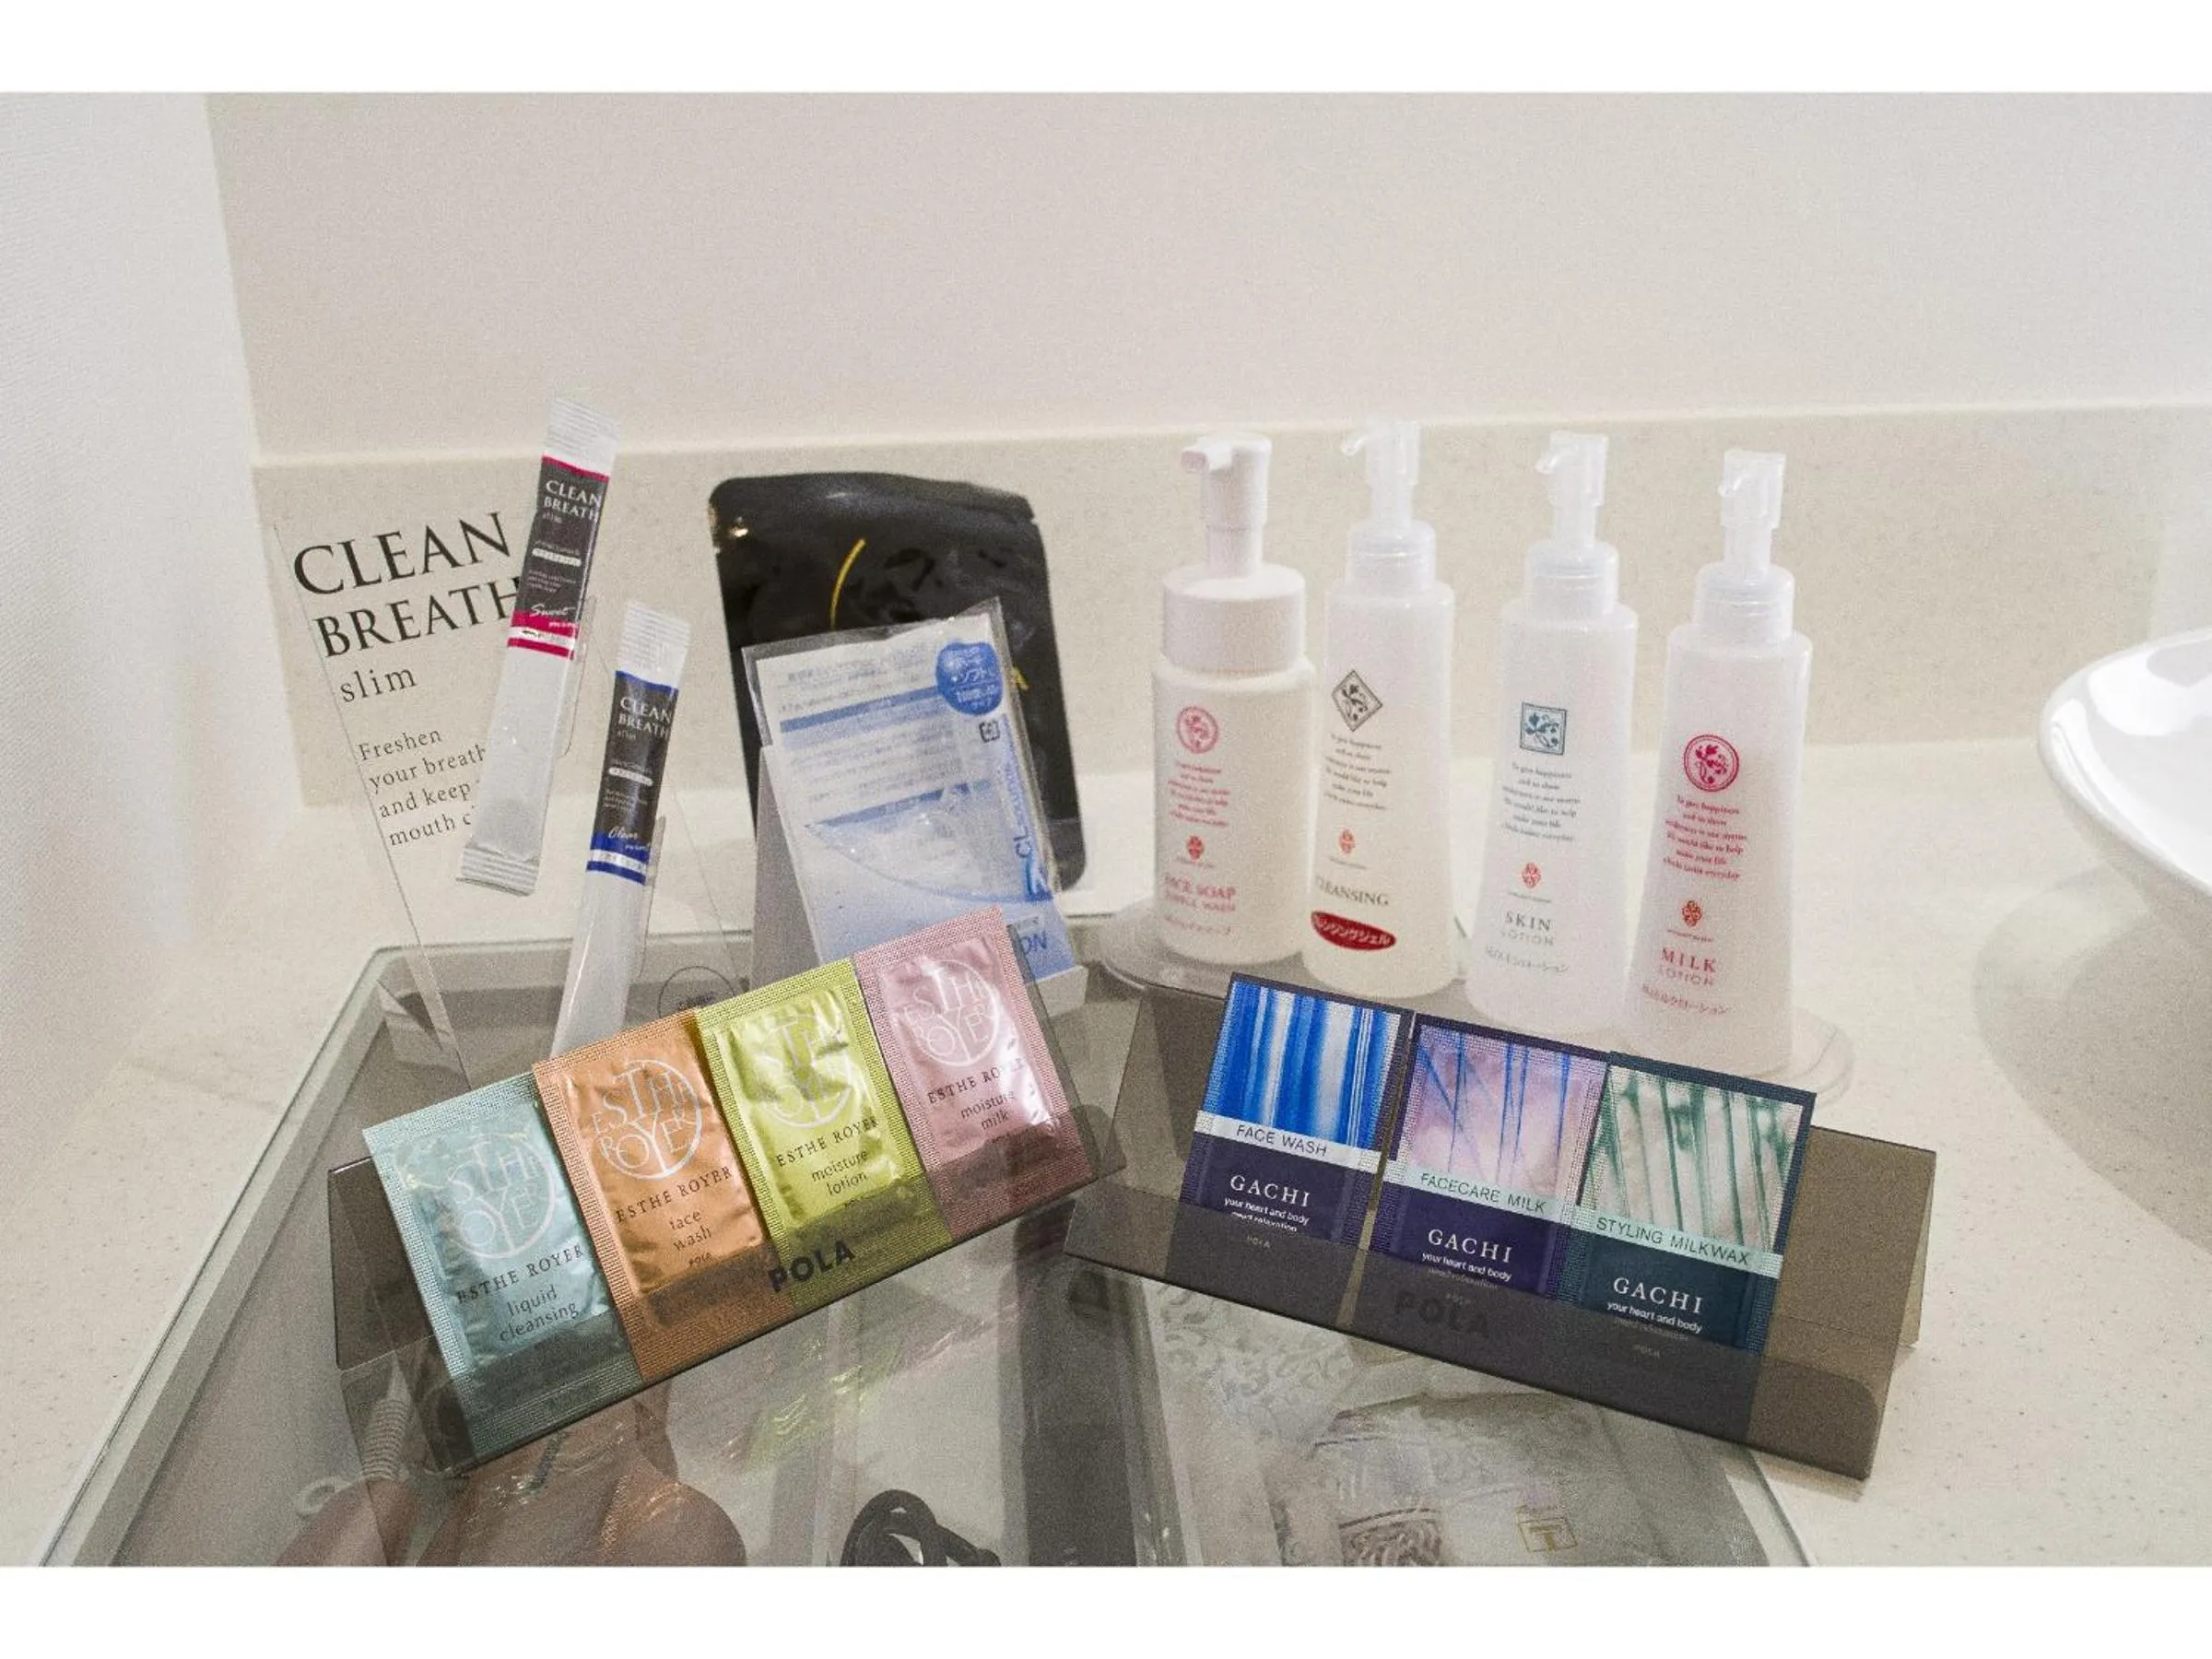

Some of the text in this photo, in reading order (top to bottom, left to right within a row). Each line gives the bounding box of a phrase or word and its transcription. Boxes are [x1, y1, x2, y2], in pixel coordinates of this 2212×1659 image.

[546, 479, 602, 506] CLEAN
[544, 496, 599, 524] BREATH
[293, 512, 512, 595] CLEAN
[340, 666, 418, 703] slim
[618, 713, 670, 738] BREATH
[619, 696, 672, 724] CLEAN
[359, 730, 442, 761] Freshen
[369, 766, 418, 794] your
[379, 782, 471, 818] and keep
[390, 813, 455, 846] mouth
[1504, 910, 1553, 932] SKIN
[1661, 947, 1716, 973] MILK
[926, 1076, 978, 1105] ESTHE
[960, 1091, 1016, 1120] moisture
[981, 1109, 1010, 1131] milk
[775, 1114, 880, 1168] ESTHE ROYER
[1236, 1124, 1328, 1158] FACE WASH
[811, 1148, 870, 1183] moisture
[615, 1165, 733, 1224] ESTHE ROYER
[826, 1171, 868, 1197] lotion
[1230, 1174, 1311, 1207] GACHI
[1420, 1171, 1547, 1216] FACECARE MILK
[669, 1209, 702, 1230] face
[1224, 1197, 1311, 1226] your heart and body
[672, 1225, 712, 1252] wash
[1428, 1228, 1513, 1265] GACHI
[1596, 1216, 1749, 1266] STYLING MILKWAX
[455, 1244, 583, 1304] ESTHE ROYER
[768, 1240, 856, 1293] POLA
[1422, 1252, 1512, 1283] your heart and body
[508, 1283, 558, 1317] liquid
[1613, 1277, 1704, 1314] GACHI
[500, 1302, 580, 1343] cleansing
[1606, 1301, 1703, 1335] your heart and body
